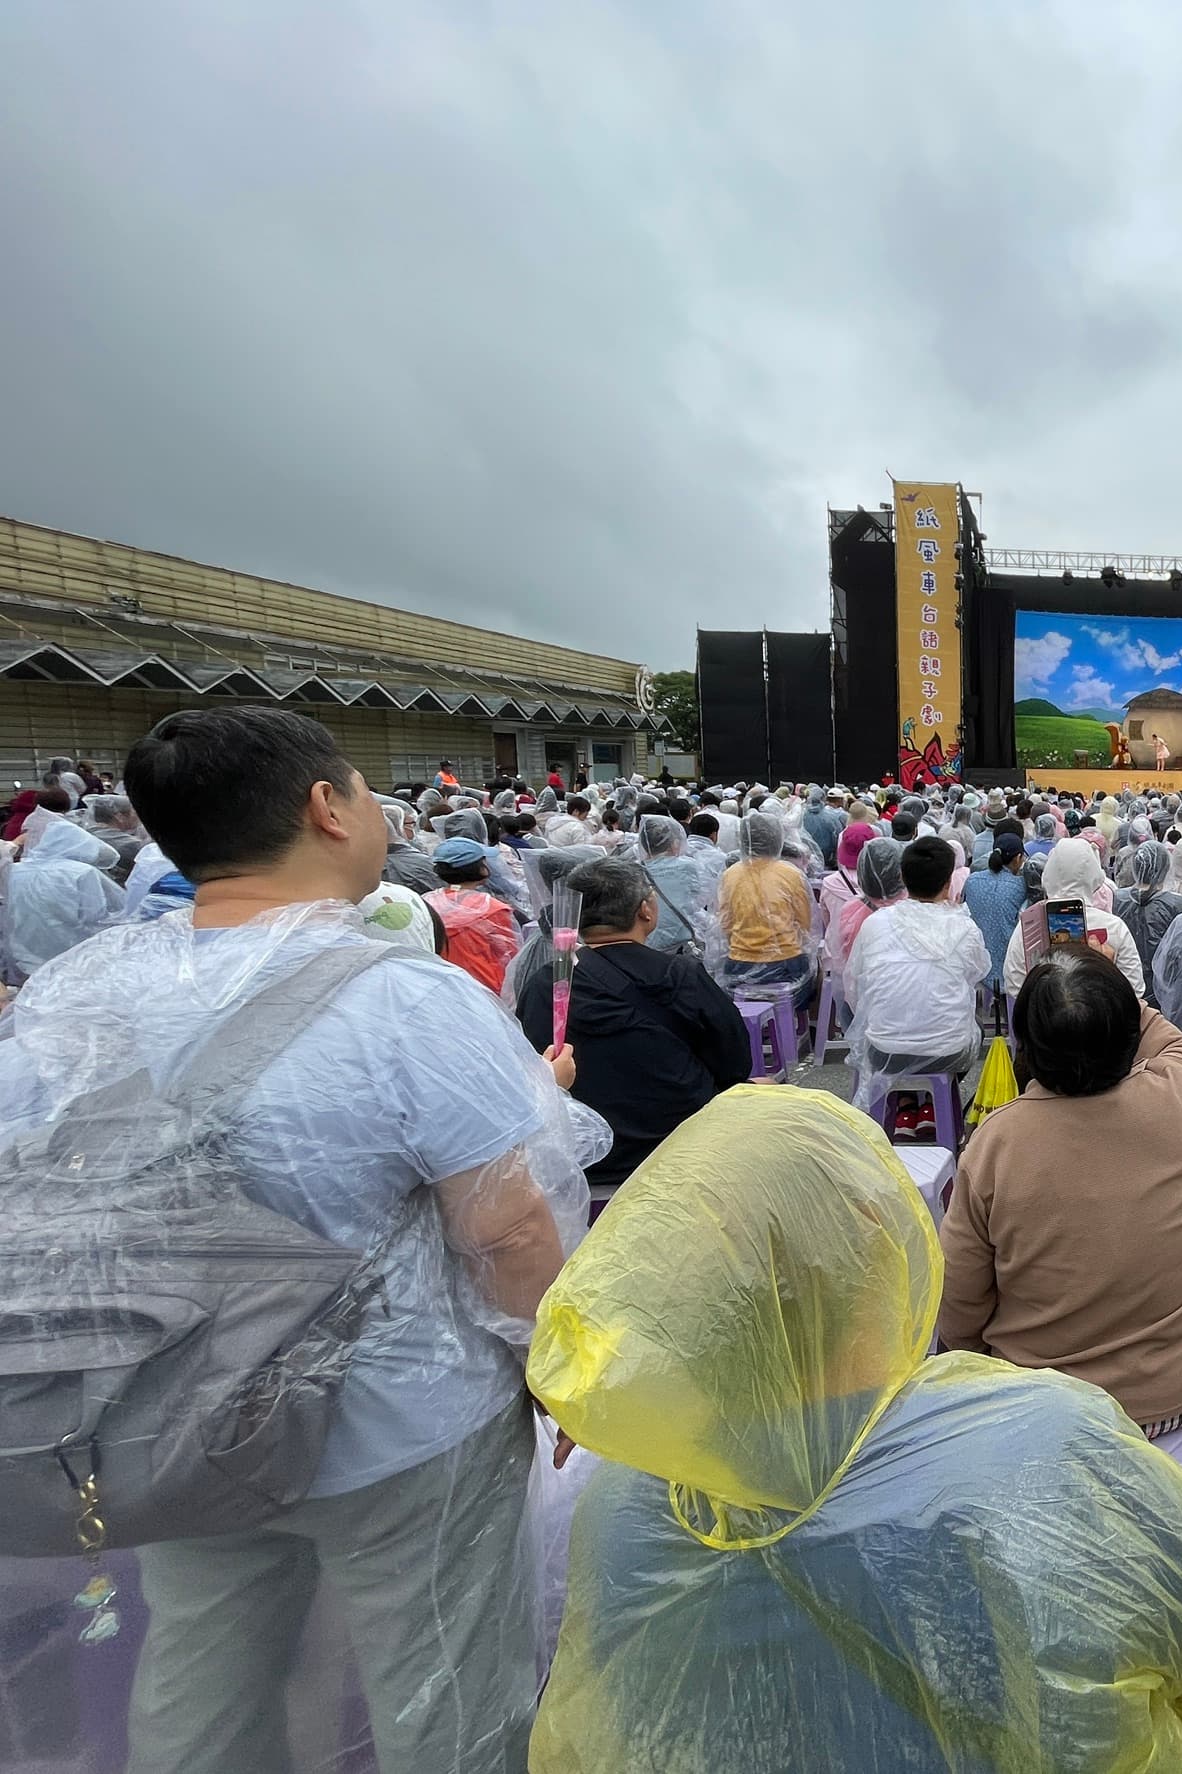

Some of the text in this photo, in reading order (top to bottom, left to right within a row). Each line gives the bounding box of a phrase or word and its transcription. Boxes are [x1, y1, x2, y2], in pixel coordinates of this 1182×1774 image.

[916, 508, 942, 726] 紙風車台語親子劇
